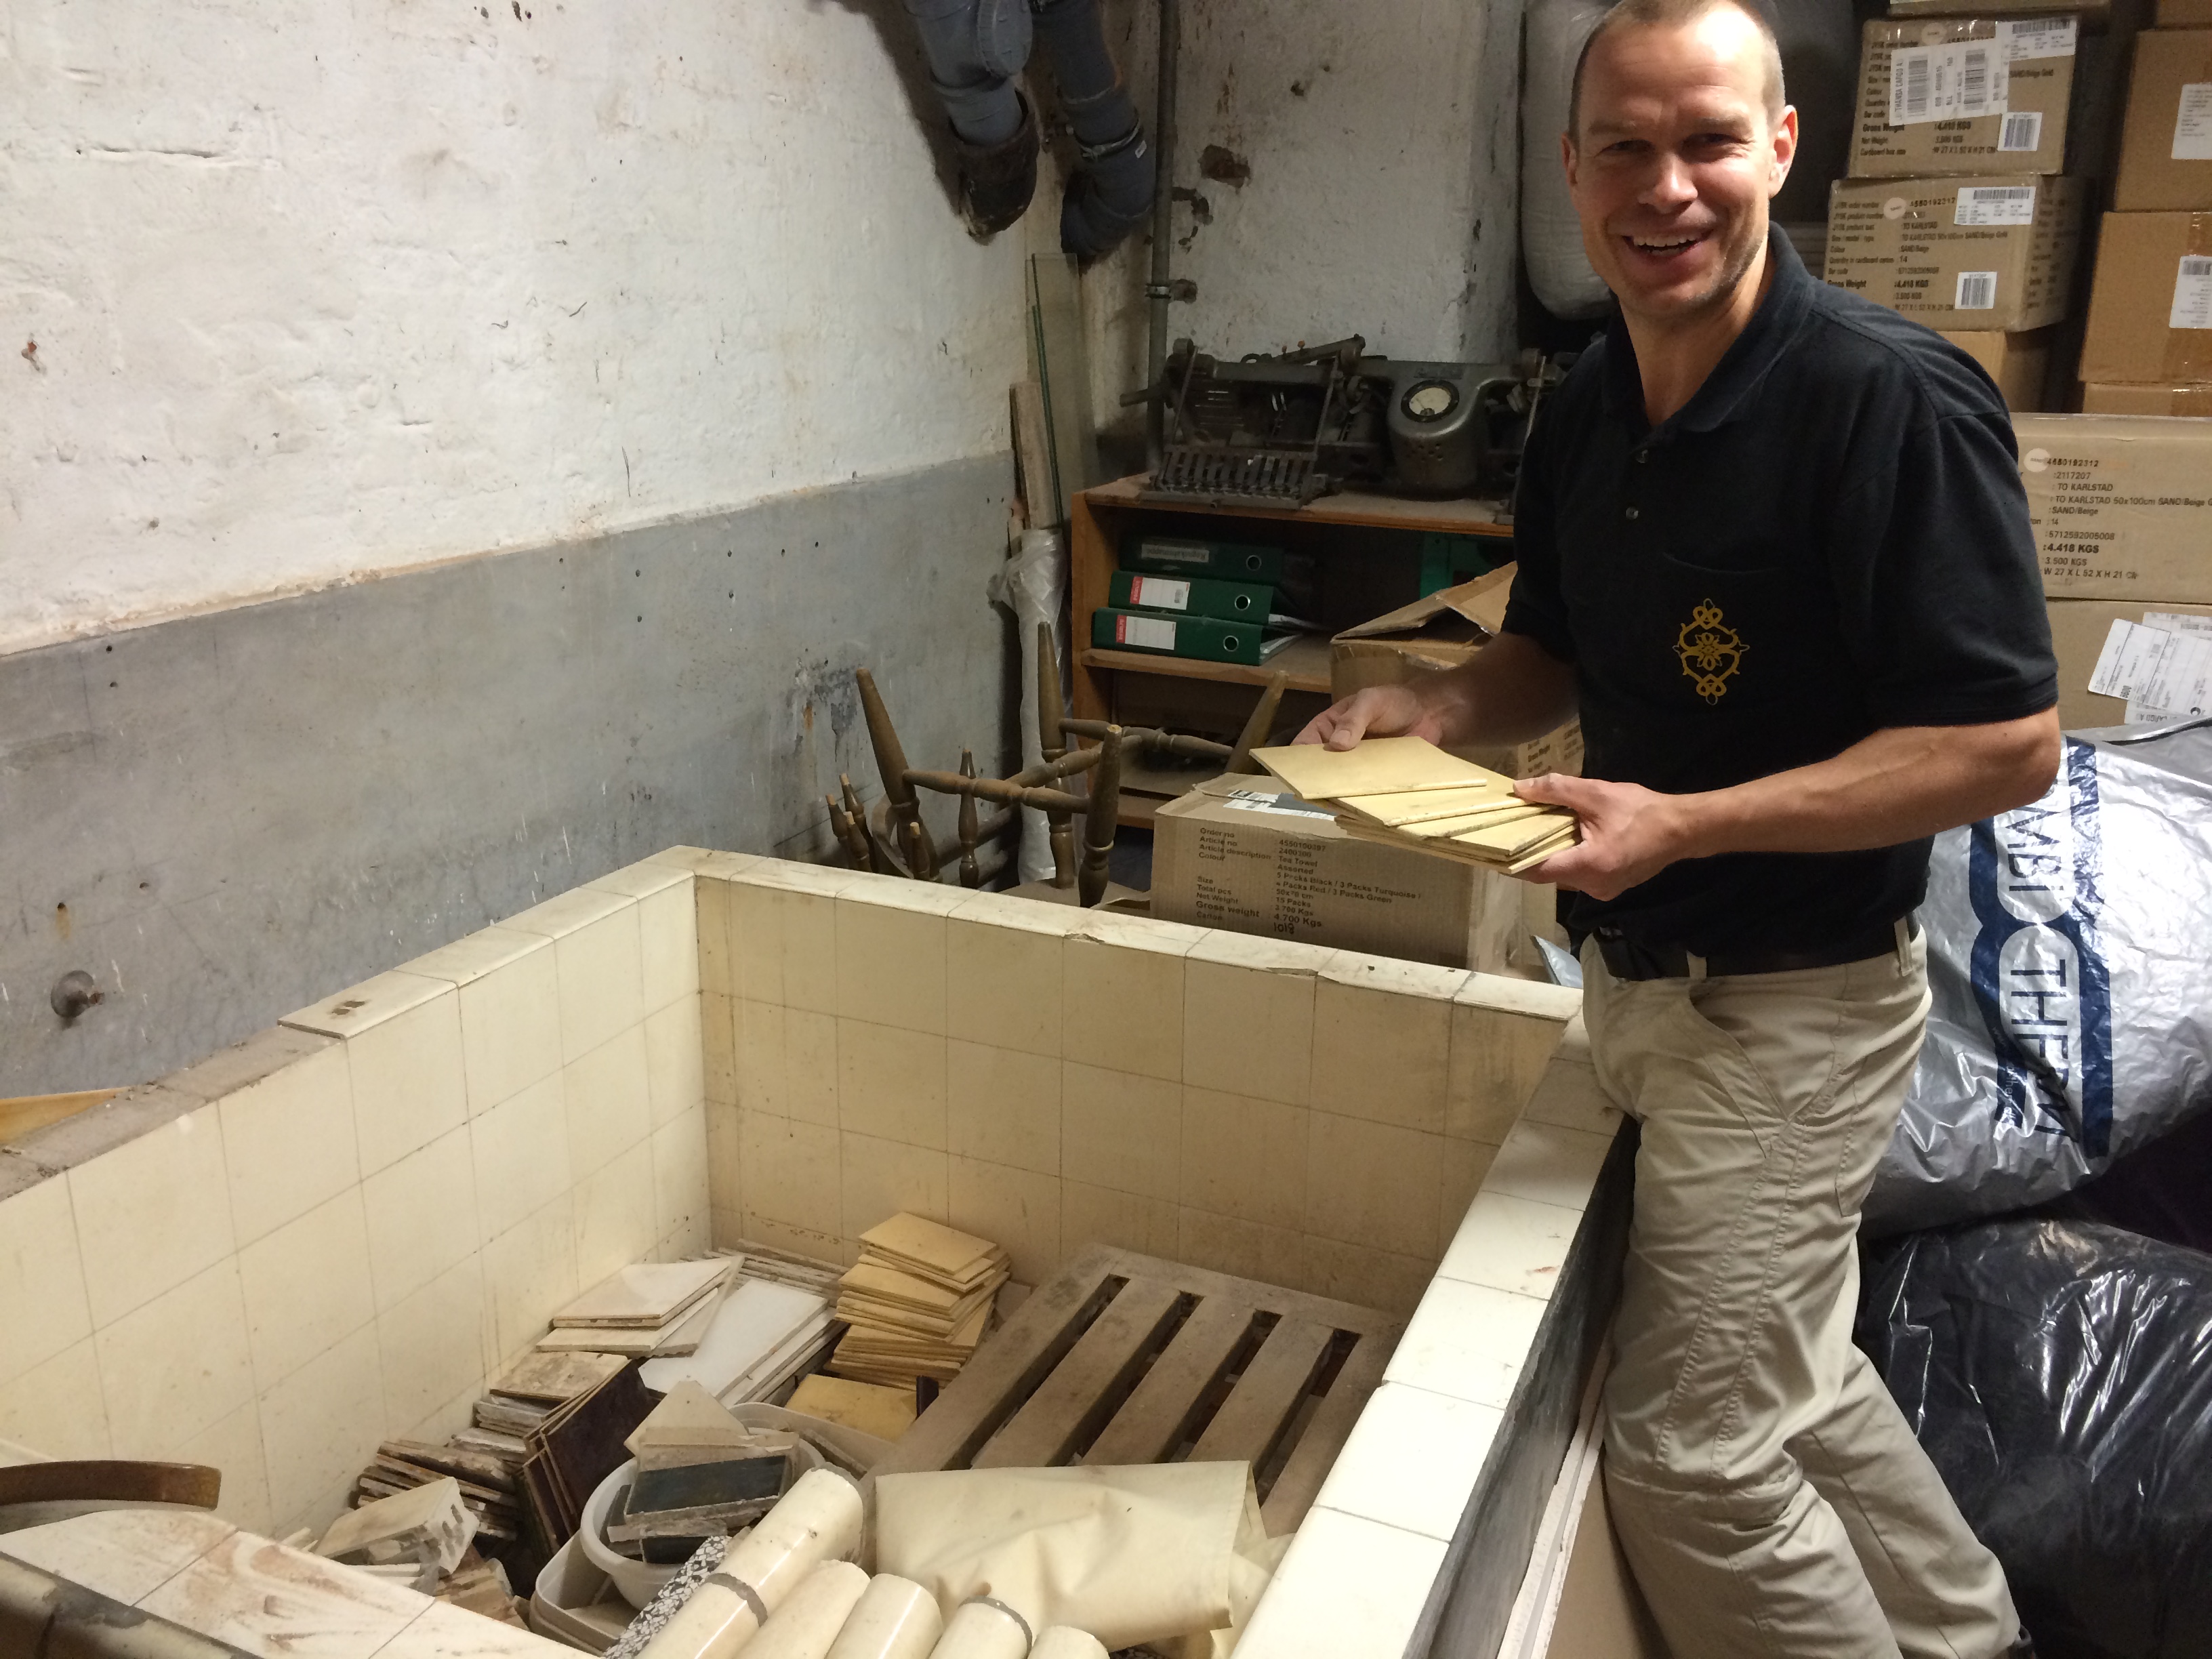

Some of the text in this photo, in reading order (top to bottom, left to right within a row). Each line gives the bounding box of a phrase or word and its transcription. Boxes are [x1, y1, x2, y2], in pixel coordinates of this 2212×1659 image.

[1846, 279, 1866, 289] Weight
[2070, 483, 2113, 491] KARLSTAD
[2068, 496, 2110, 504] KARLSTAD
[2113, 497, 2156, 506] 50x100cm
[2078, 544, 2099, 554] KGS
[2071, 558, 2087, 567] KGS
[2067, 568, 2073, 576] X
[2075, 569, 2080, 577] L
[2095, 570, 2102, 578] X
[2113, 571, 2123, 579] 21
[1200, 827, 1223, 836] Order
[1200, 836, 1225, 845] Article
[1199, 844, 1225, 853] Article
[1227, 848, 1271, 860] description
[1295, 858, 1317, 867] Towel
[1199, 852, 1313, 875] Colour Assorted
[1283, 881, 1307, 891] Packs
[1309, 885, 1326, 893] Red
[1340, 889, 1364, 899] Packs
[1367, 894, 1392, 904] Green
[1310, 877, 1332, 886] Black
[1347, 882, 1372, 893] Packs
[1374, 886, 1416, 899] Turquoise
[1197, 884, 1215, 893] Total
[1288, 898, 1311, 908] Packs
[1212, 894, 1238, 904] Weight
[1298, 907, 1313, 916] Kgs
[1196, 901, 1322, 928] Gross weight 4.700 Kgs
[1197, 912, 1223, 920] Carton
